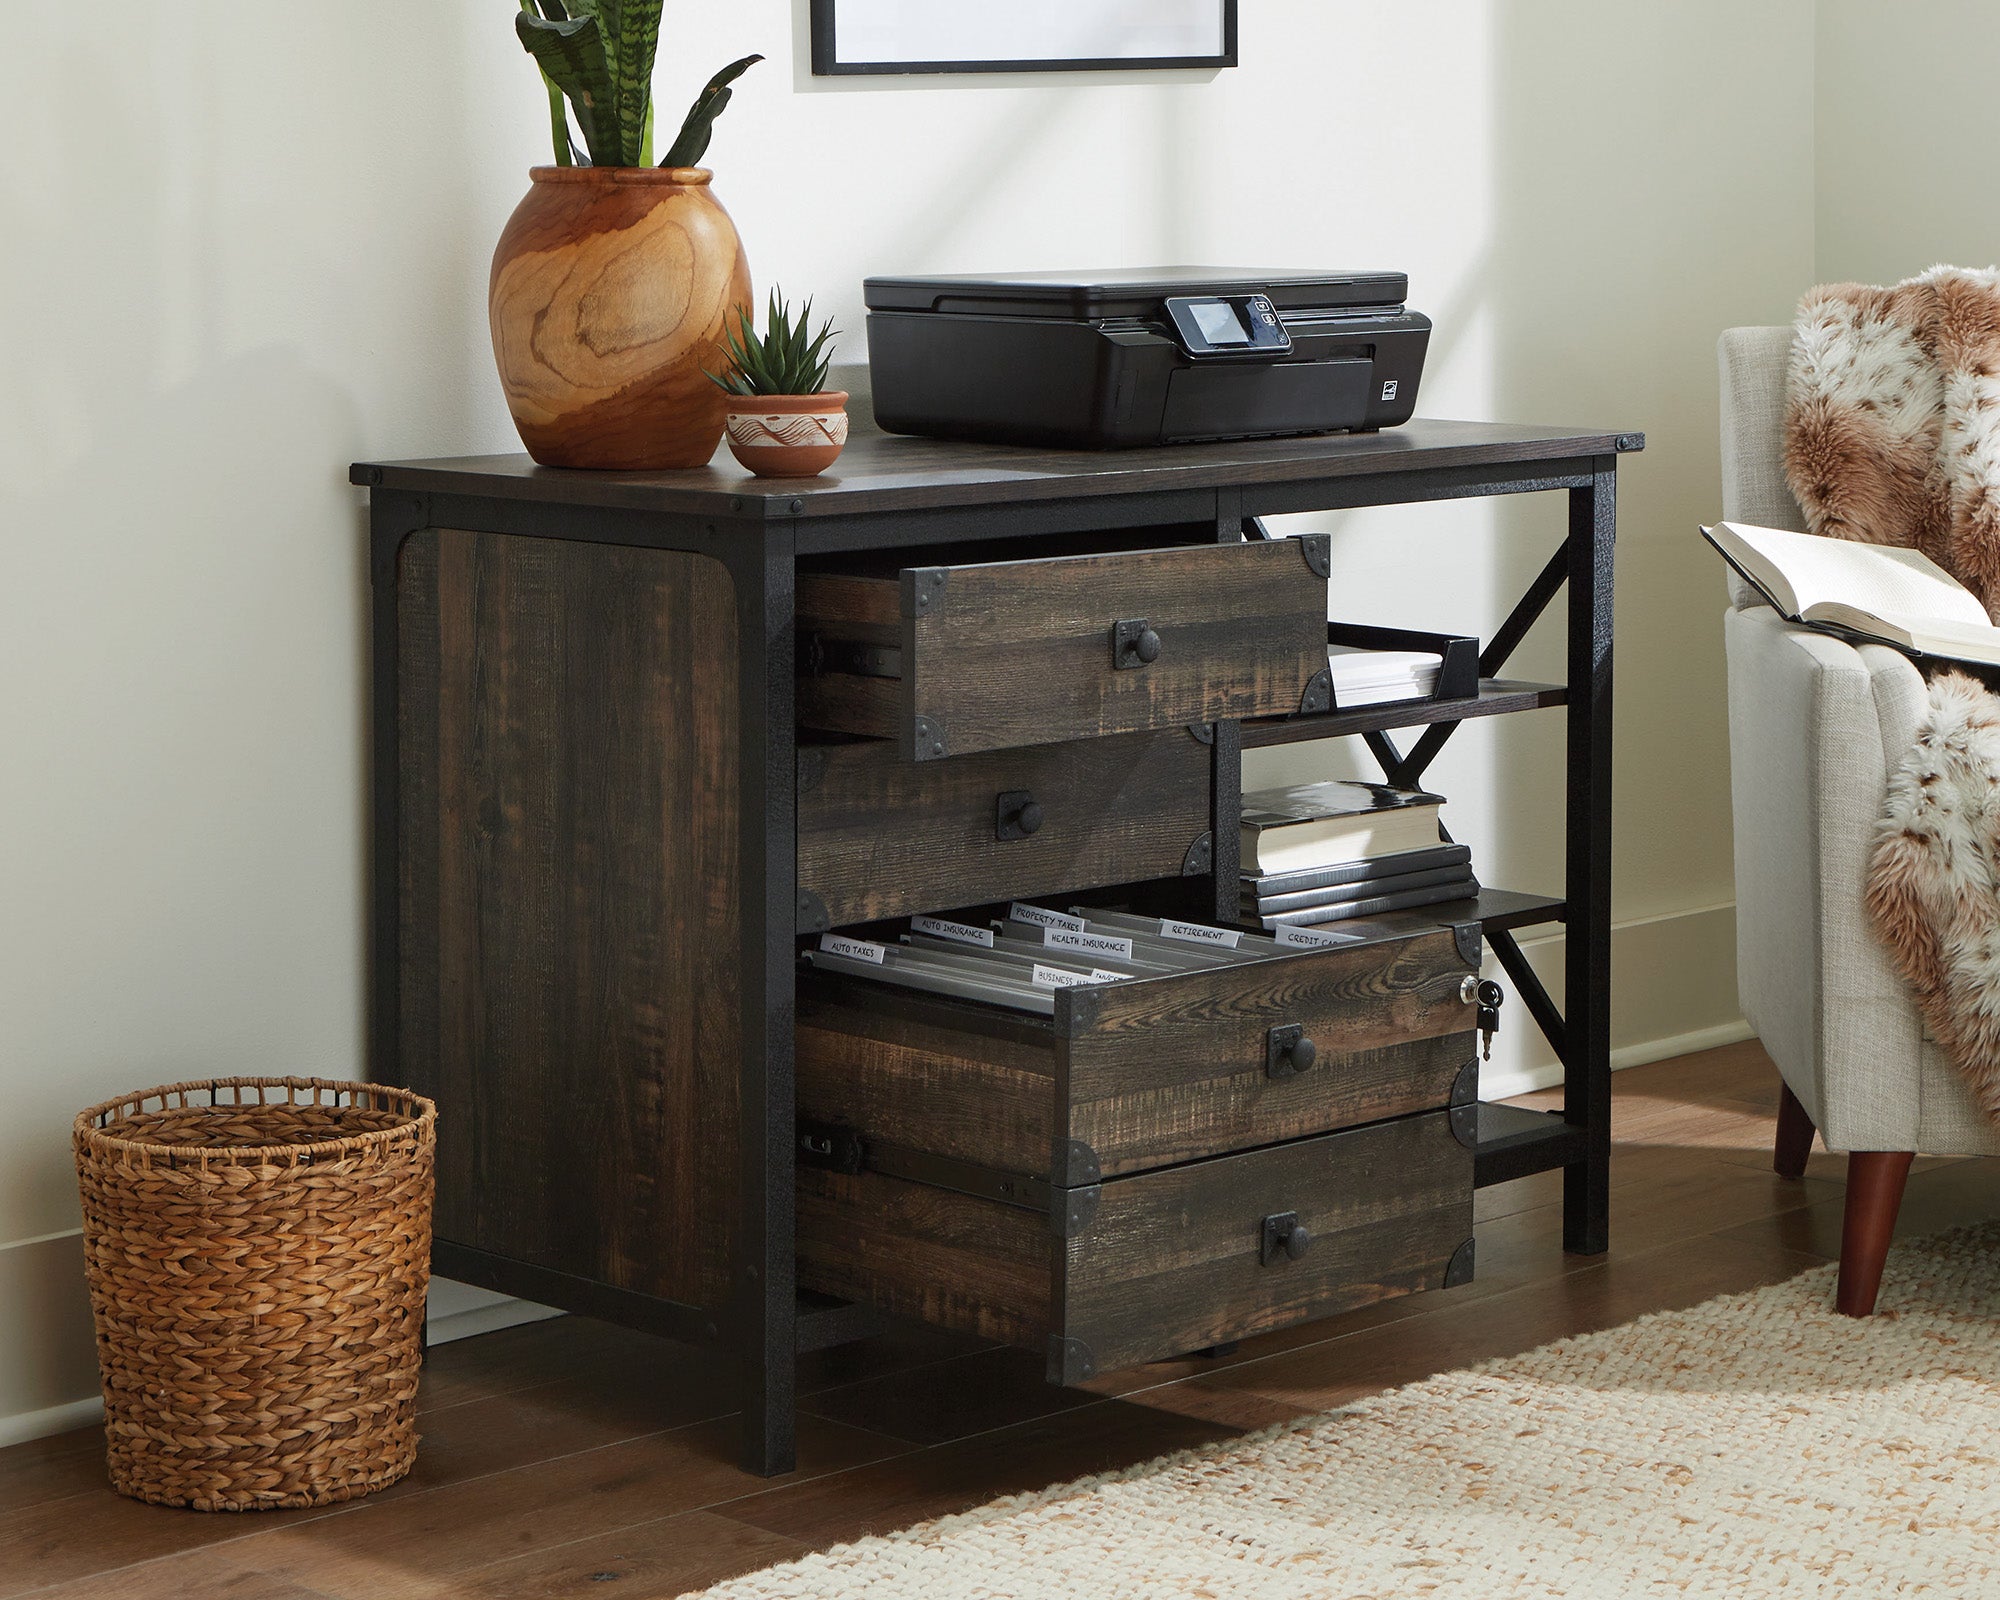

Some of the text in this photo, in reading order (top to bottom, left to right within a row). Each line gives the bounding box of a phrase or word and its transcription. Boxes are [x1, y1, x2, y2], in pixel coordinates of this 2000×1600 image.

[1016, 908, 1079, 932] PROPERTY TAXES
[922, 920, 983, 939] AUTO INSURANCE
[1172, 925, 1224, 940] RETIREMENT
[1051, 934, 1125, 951] HEALTH INSURANCE
[1288, 933, 1319, 945] CREDIT
[832, 943, 874, 957] AUTO TAXES
[1039, 972, 1073, 985] BUSINESS
